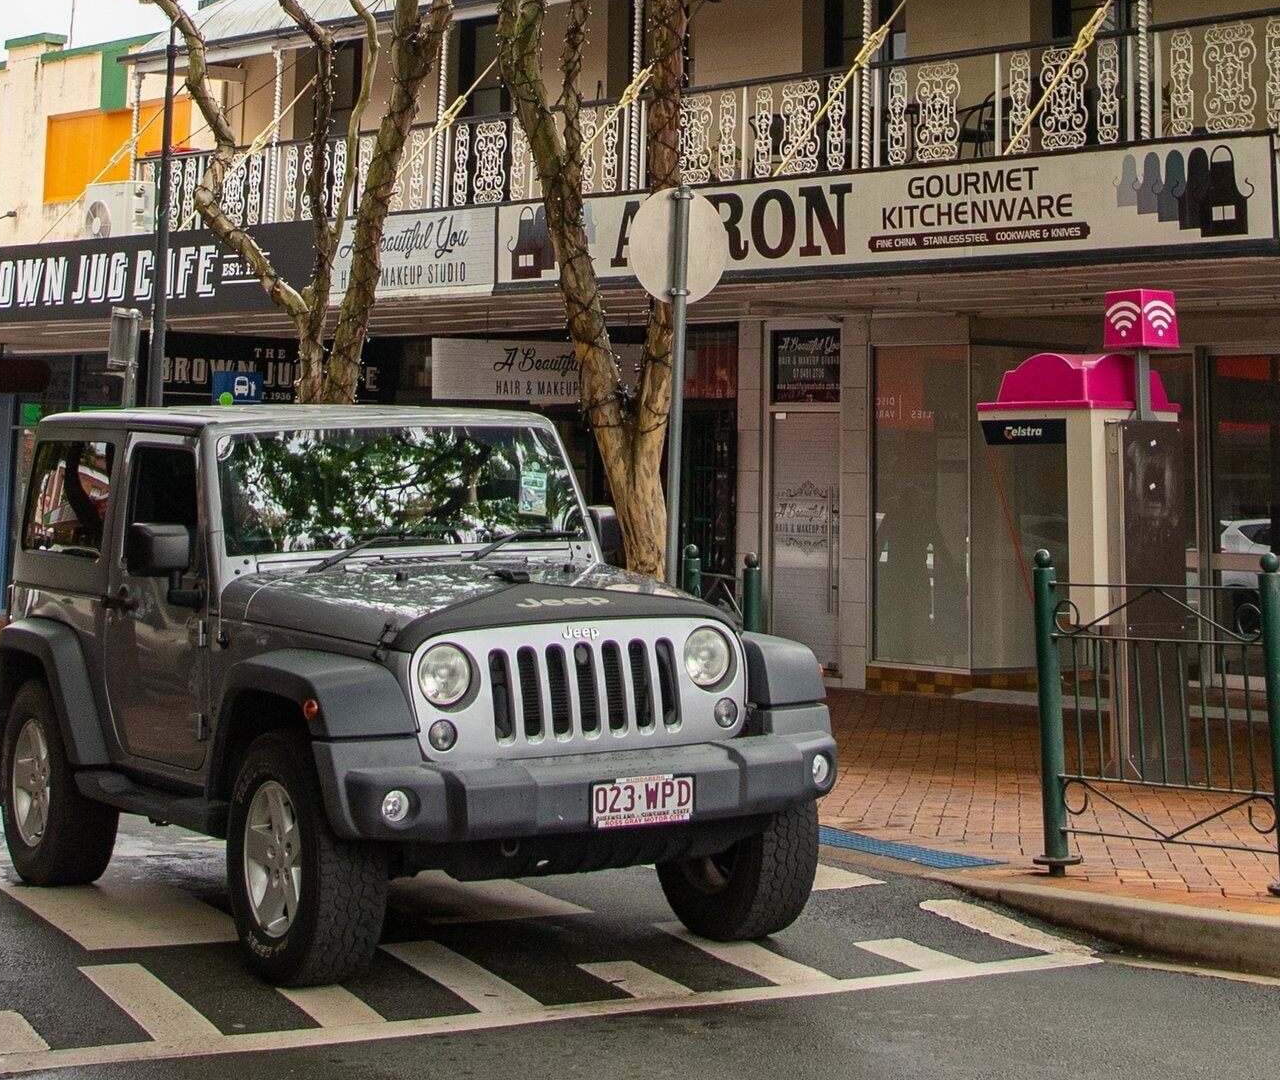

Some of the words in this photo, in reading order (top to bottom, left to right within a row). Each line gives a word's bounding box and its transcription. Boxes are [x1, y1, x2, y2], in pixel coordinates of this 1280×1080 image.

[908, 166, 1039, 200] GOURMET
[882, 193, 1073, 230] KITCHENWARE
[380, 220, 434, 260] eautiful
[435, 215, 469, 259] You
[876, 239, 893, 249] FINE
[894, 236, 917, 248] CHINA
[995, 229, 1041, 241] COOKWARE
[1042, 228, 1049, 238] &
[1051, 227, 1081, 238] KNIVES
[72, 252, 129, 303] JUG
[133, 245, 218, 301] CFE
[222, 262, 243, 276] EST.
[381, 265, 423, 287] MAKEUP
[427, 261, 466, 284] STUDIO
[254, 347, 286, 359] THE
[493, 347, 518, 372] A
[519, 347, 581, 377] Beautifu
[263, 362, 302, 388] JU
[270, 392, 291, 401] 1936
[496, 380, 520, 395] HAIR
[525, 382, 532, 395] &
[537, 381, 579, 396] MAKEUP
[1003, 426, 1043, 440] Telstra
[516, 597, 610, 608] Jeep
[562, 626, 600, 640] Jeep
